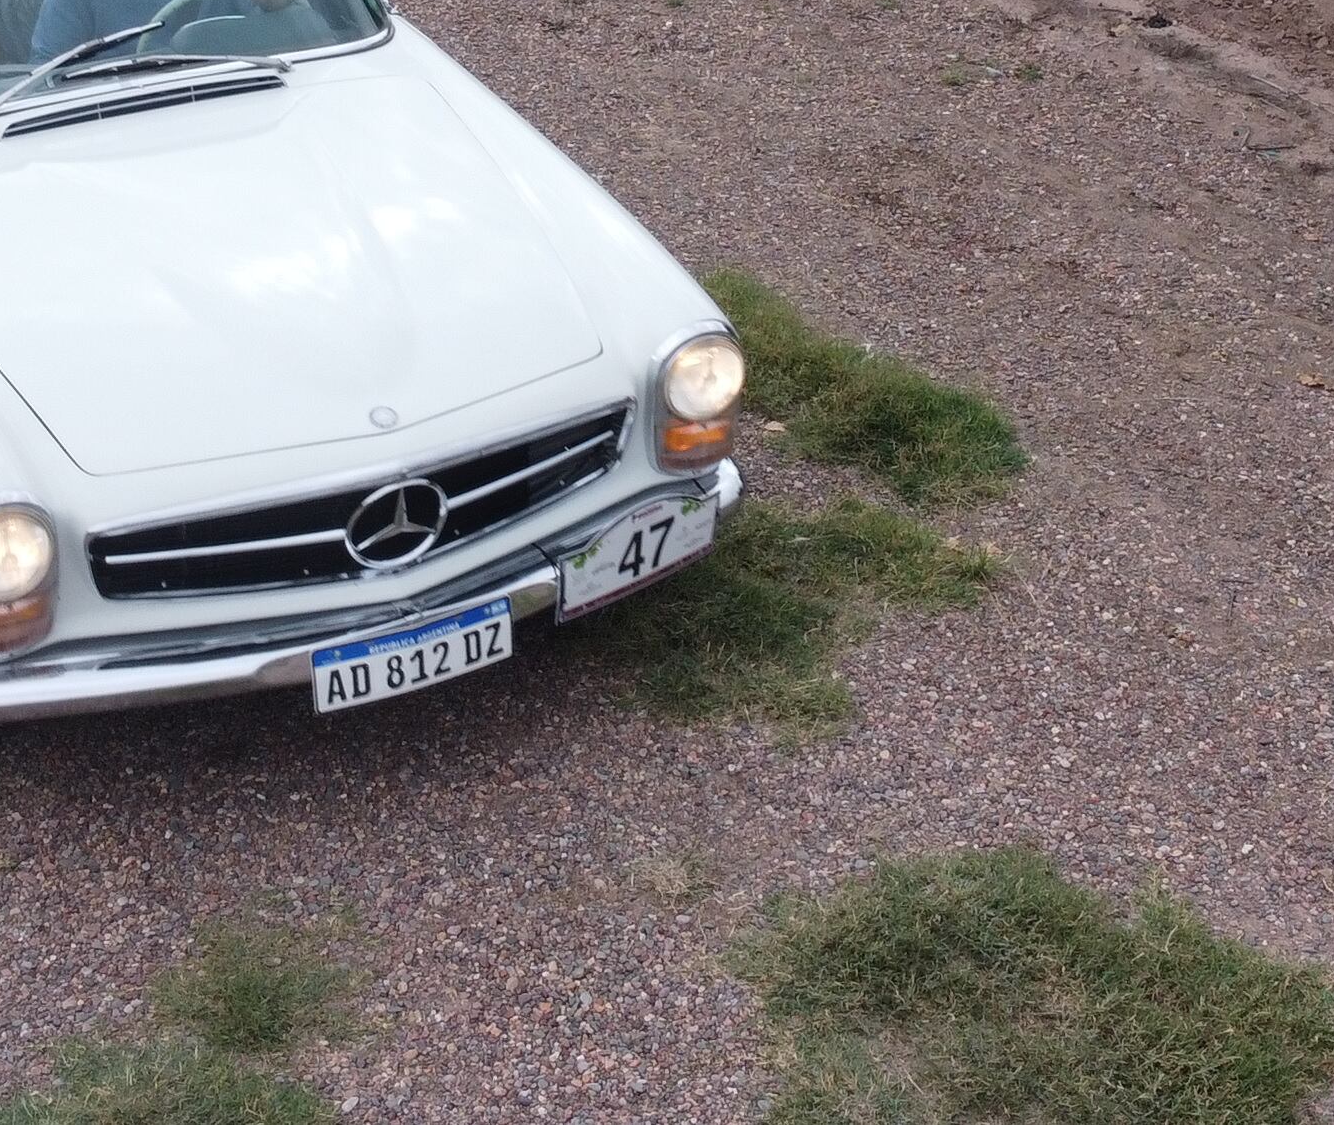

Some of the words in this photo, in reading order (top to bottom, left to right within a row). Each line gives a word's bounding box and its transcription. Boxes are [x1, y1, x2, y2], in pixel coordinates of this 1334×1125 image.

[618, 515, 675, 577] 47
[327, 662, 371, 705] AD
[386, 641, 451, 690] 812
[463, 621, 504, 666] DZ
